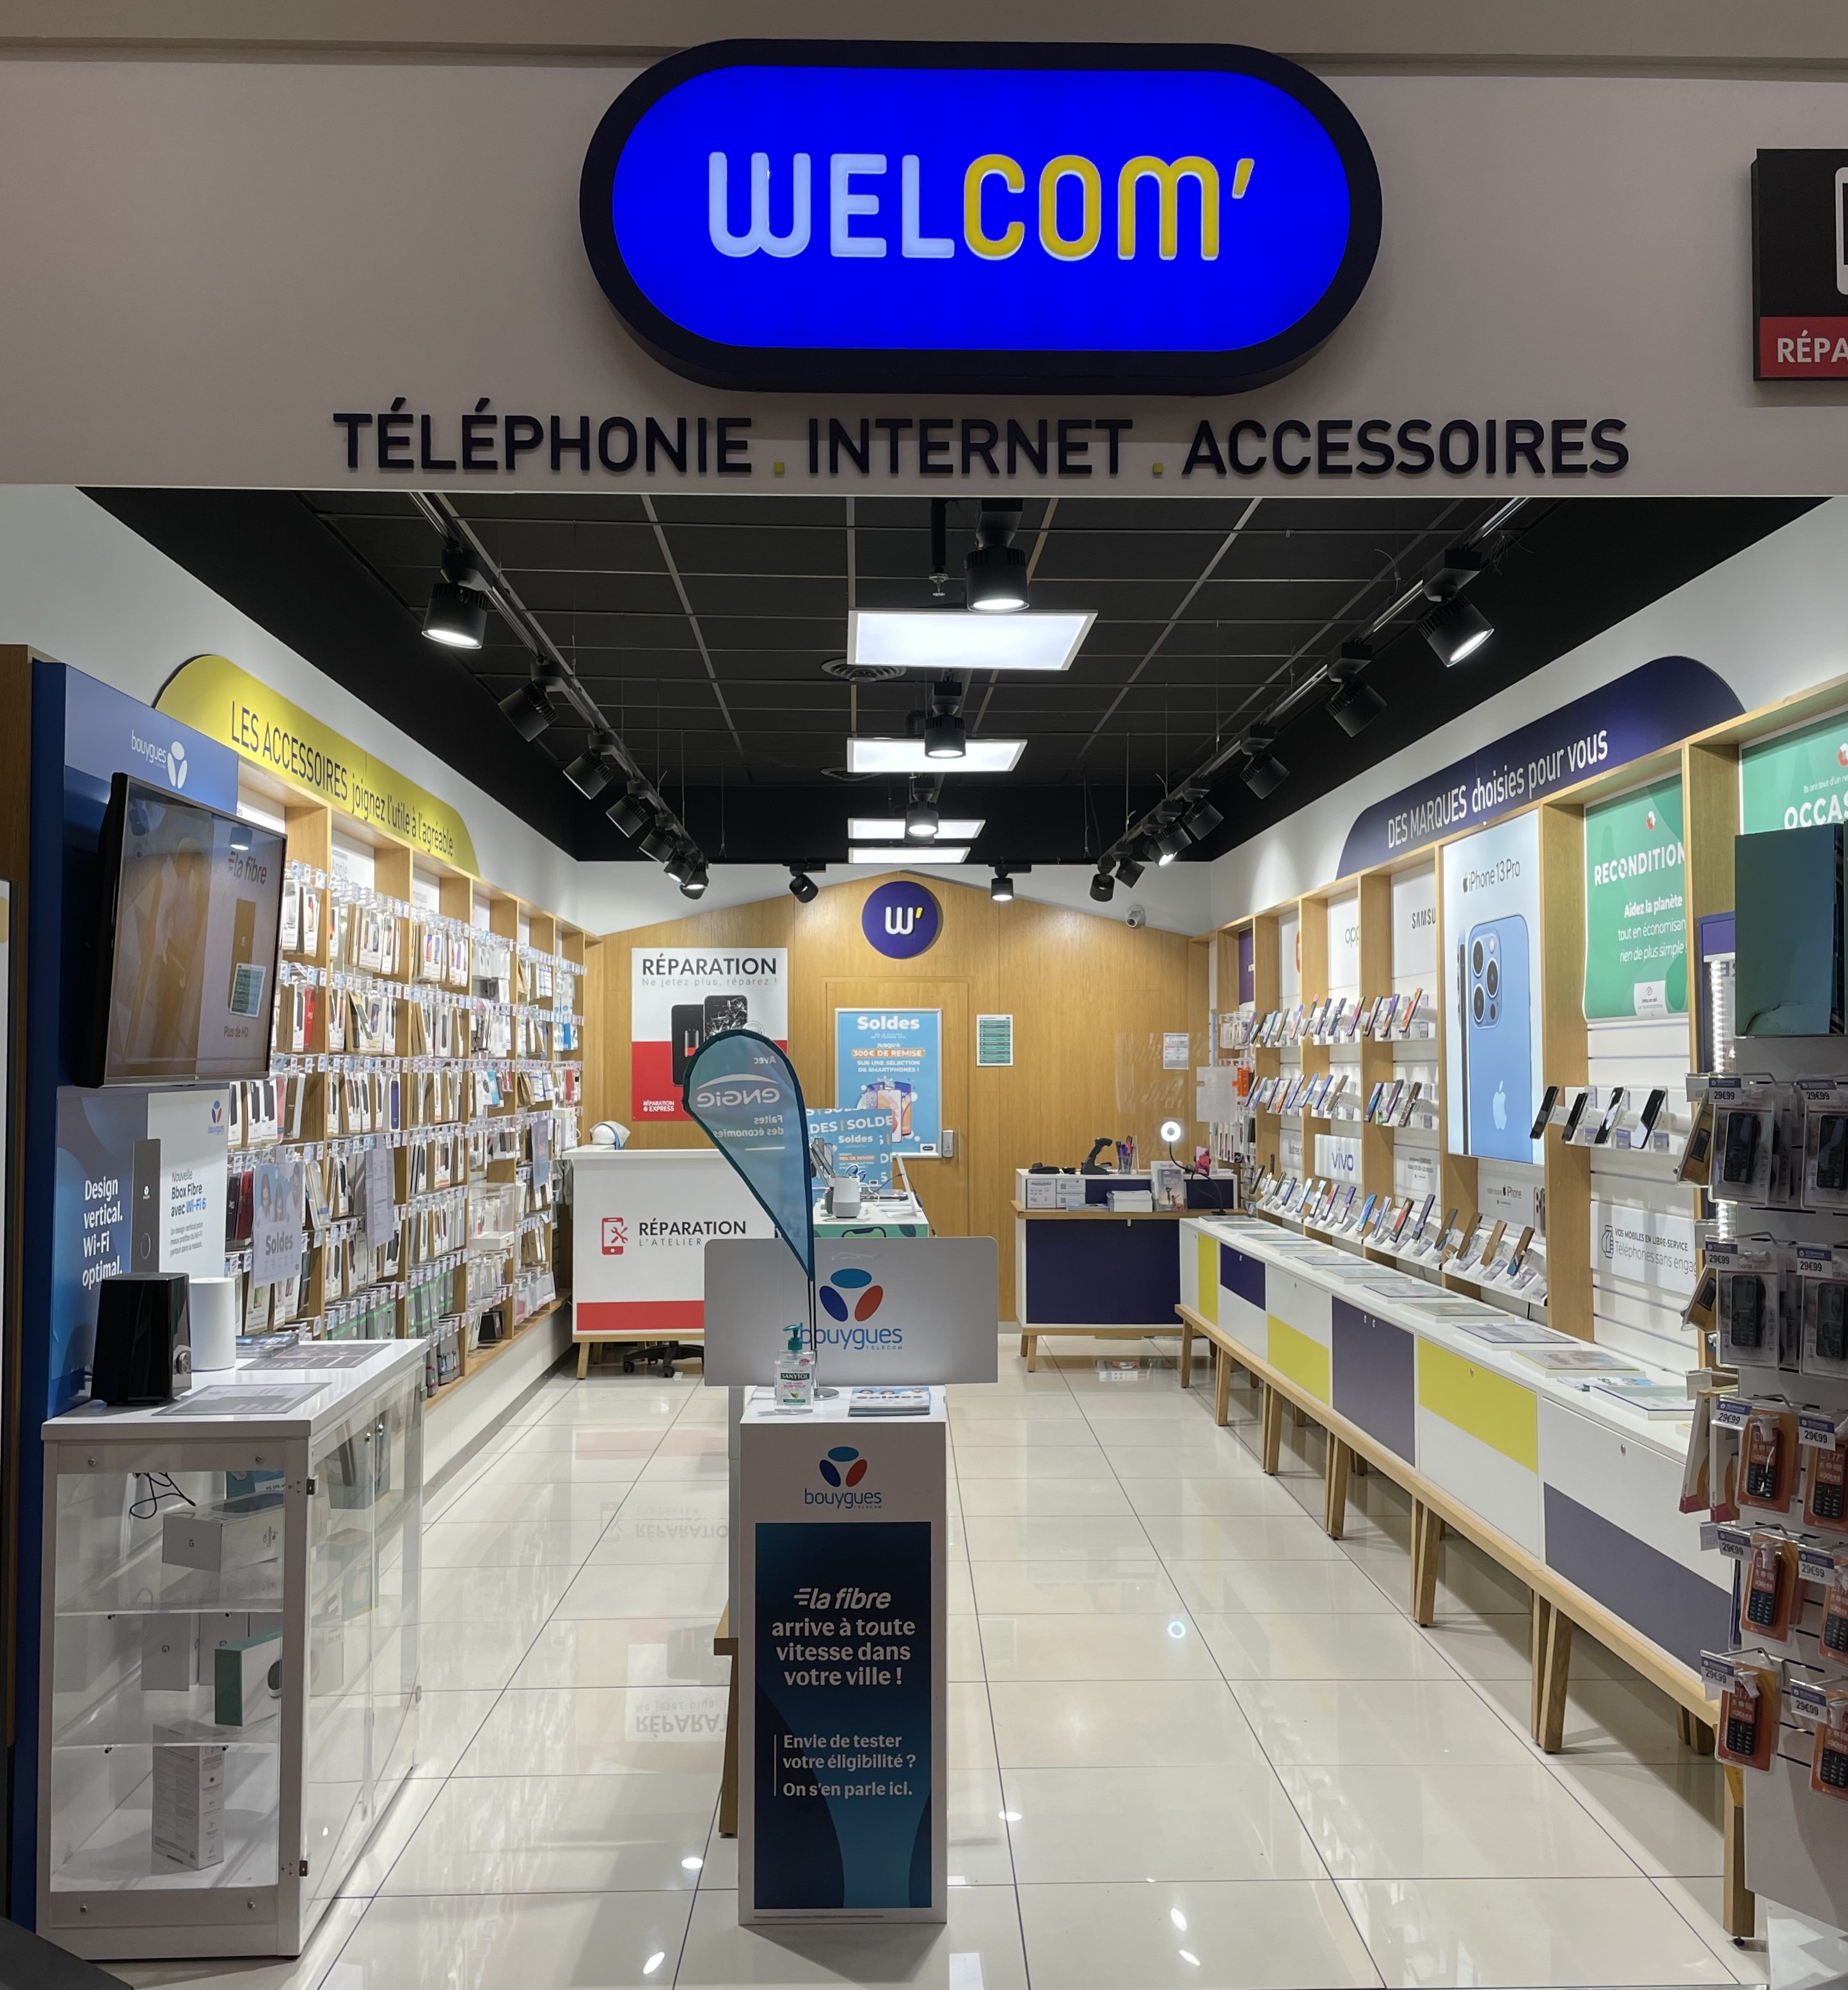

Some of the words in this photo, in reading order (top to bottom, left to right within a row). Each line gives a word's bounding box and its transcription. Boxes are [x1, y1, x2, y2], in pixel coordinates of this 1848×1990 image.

[708, 151, 1255, 264] WELCOM'
[1777, 330, 1848, 363] RÉPA
[333, 397, 754, 475] TÉLÉPHONIE
[808, 417, 1134, 477] INTERNET
[1183, 418, 1628, 479] ACCESSOIRES
[131, 729, 166, 763] bouygues
[231, 700, 259, 752] LES
[262, 722, 347, 801] ACCESSOIRES
[351, 774, 385, 821] joignez
[386, 792, 410, 834] l'utile
[418, 812, 454, 857] l'agréable
[1388, 811, 1408, 849] DES
[1410, 784, 1467, 840] MARQUES
[1472, 764, 1525, 813] choisies
[1528, 749, 1565, 800] pour
[1567, 729, 1609, 772] vous
[1784, 790, 1848, 829] OCCA
[234, 853, 243, 880] la
[244, 856, 267, 886] fibre
[1594, 841, 1685, 886] RECONDITION
[1468, 865, 1495, 893] iPhone
[1496, 861, 1505, 880] 13
[1506, 859, 1520, 880] Pro
[1624, 902, 1645, 918] Aidez
[1645, 900, 1652, 914] la
[1653, 894, 1682, 915] planète
[1412, 907, 1436, 929] SAMSU
[1345, 926, 1360, 948] op
[1618, 928, 1632, 941] tout
[1633, 929, 1642, 939] en
[1643, 918, 1686, 936] économisan
[1620, 950, 1632, 962] rien
[1634, 946, 1642, 960] de
[1643, 944, 1658, 962] plus
[1659, 940, 1684, 959] simple
[642, 952, 777, 976] RÉPARATION
[642, 978, 656, 986] Ne
[660, 978, 689, 988] jetez
[694, 977, 722, 988] plus,
[727, 977, 769, 987] réparez
[857, 1015, 920, 1030] Soldes
[1714, 1090, 1735, 1101] 29€99
[1806, 1091, 1830, 1101] 29€99
[808, 1121, 838, 1134] DES
[846, 1116, 892, 1131] SOLDE
[838, 1134, 873, 1144] Soldes
[171, 1169, 193, 1182] Nouvelle
[84, 1176, 118, 1202] Design
[171, 1186, 186, 1200] Bbox
[187, 1182, 202, 1197] Fibre
[83, 1200, 123, 1229] vertical.
[171, 1204, 185, 1217] avec
[186, 1197, 202, 1213] Wi-Fi
[202, 1197, 207, 1210] 6
[639, 1218, 747, 1236] RÉPARATION
[83, 1232, 110, 1258] Wi-Fi
[265, 1230, 293, 1257] Soldes
[1614, 1227, 1624, 1238] VOS
[1625, 1230, 1645, 1242] MOBILES
[1645, 1234, 1652, 1243] EN
[1653, 1236, 1688, 1252] LIBRE-SERVICE
[1614, 1240, 1654, 1263] Téléphones
[1655, 1253, 1672, 1268] sans
[1674, 1257, 1696, 1276] enga
[1709, 1254, 1730, 1265] 29€99
[1799, 1261, 1822, 1272] 29€99
[82, 1255, 123, 1290] optimal.
[800, 1323, 903, 1350] bouygues
[1717, 1413, 1740, 1425] 29€99
[1804, 1430, 1828, 1444] 29€99
[804, 1488, 882, 1509] bouygues
[1722, 1543, 1744, 1556] 29€99
[1801, 1564, 1825, 1578] 29€99
[809, 1588, 831, 1609] la
[834, 1588, 892, 1609] fibre
[772, 1618, 834, 1637] arrive
[839, 1618, 852, 1637] à
[856, 1618, 916, 1637] toute
[776, 1643, 854, 1661] vitesse
[857, 1642, 911, 1661] dans
[784, 1669, 841, 1686] votre
[846, 1668, 891, 1686] ville
[1705, 1668, 1727, 1684] 29€99
[1796, 1699, 1819, 1716] 29€99
[783, 1734, 827, 1749] Envie
[830, 1734, 850, 1748] de
[854, 1735, 902, 1748] tester
[783, 1755, 824, 1769] votre
[827, 1754, 904, 1772] éligibilité
[783, 1783, 806, 1797] On
[809, 1782, 841, 1797] s'en
[844, 1781, 886, 1799] parle
[889, 1781, 913, 1795] ici.
